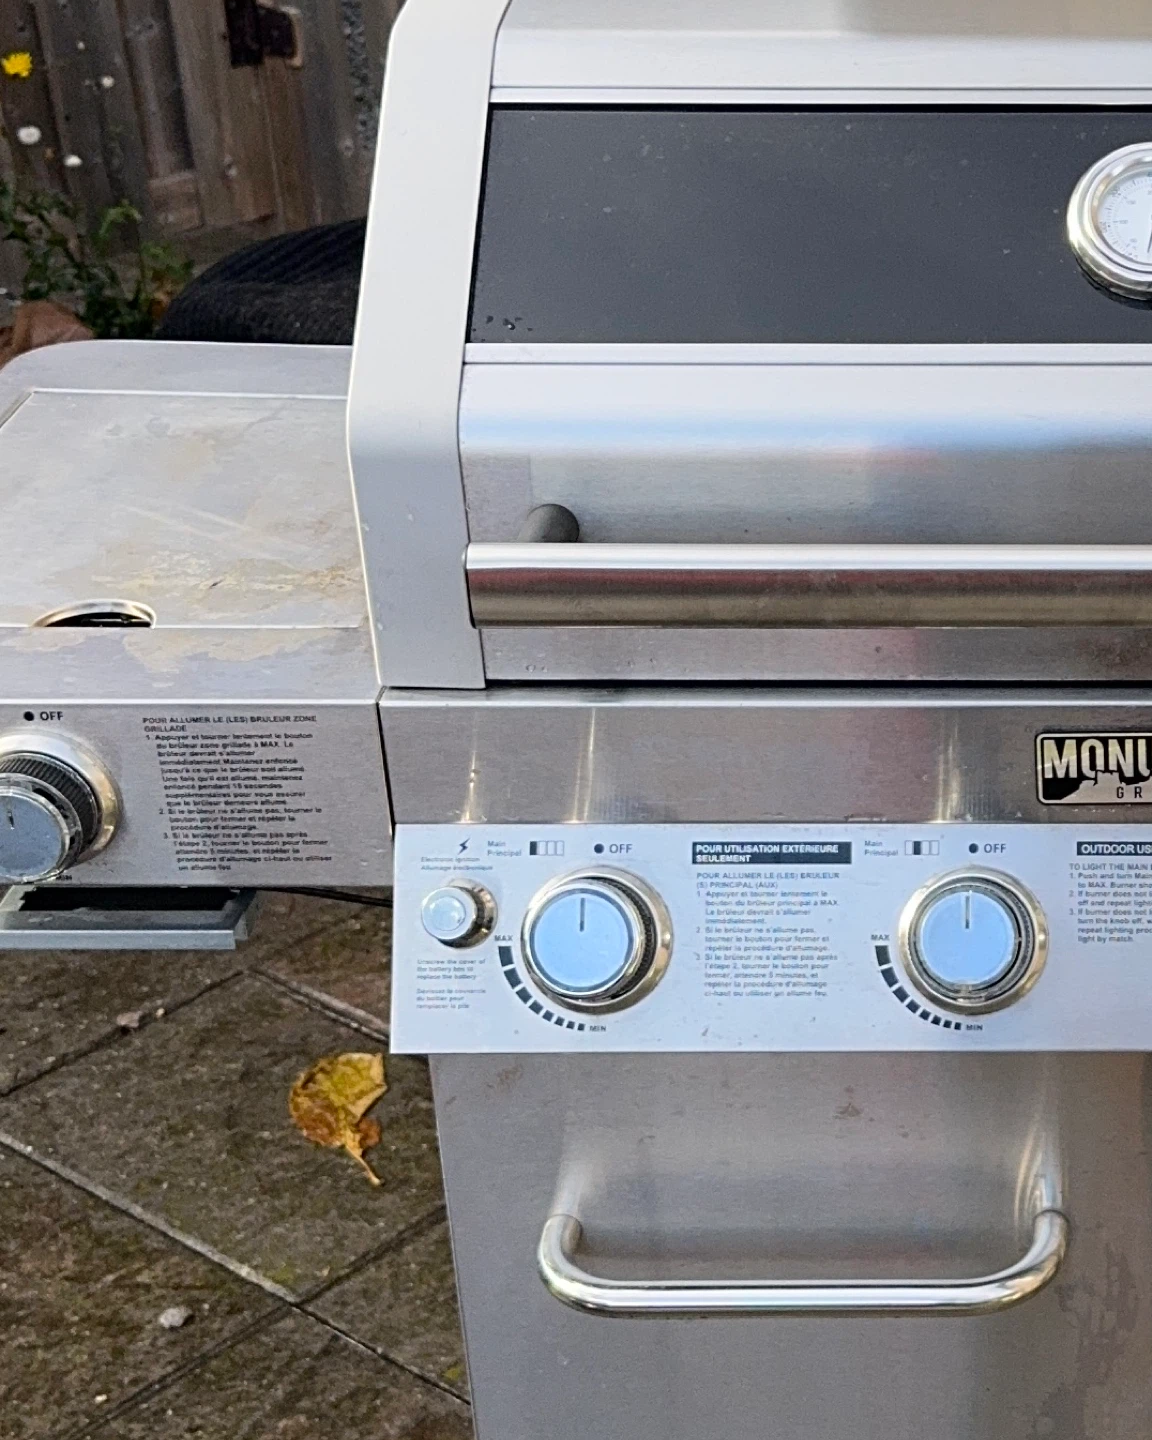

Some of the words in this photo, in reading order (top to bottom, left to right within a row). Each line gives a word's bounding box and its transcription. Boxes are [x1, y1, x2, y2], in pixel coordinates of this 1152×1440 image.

[40, 712, 63, 720] OFF
[609, 844, 632, 854] OFF
[696, 845, 722, 853] POUR
[724, 845, 780, 853] UTILISATION
[984, 844, 1006, 853] OFF
[1081, 845, 1135, 854] OUTDOOR
[487, 849, 521, 857] Principal
[1069, 863, 1080, 871] TO
[1083, 863, 1106, 871] LIGHT
[1109, 863, 1125, 871] THE
[1127, 863, 1148, 871] MAIN
